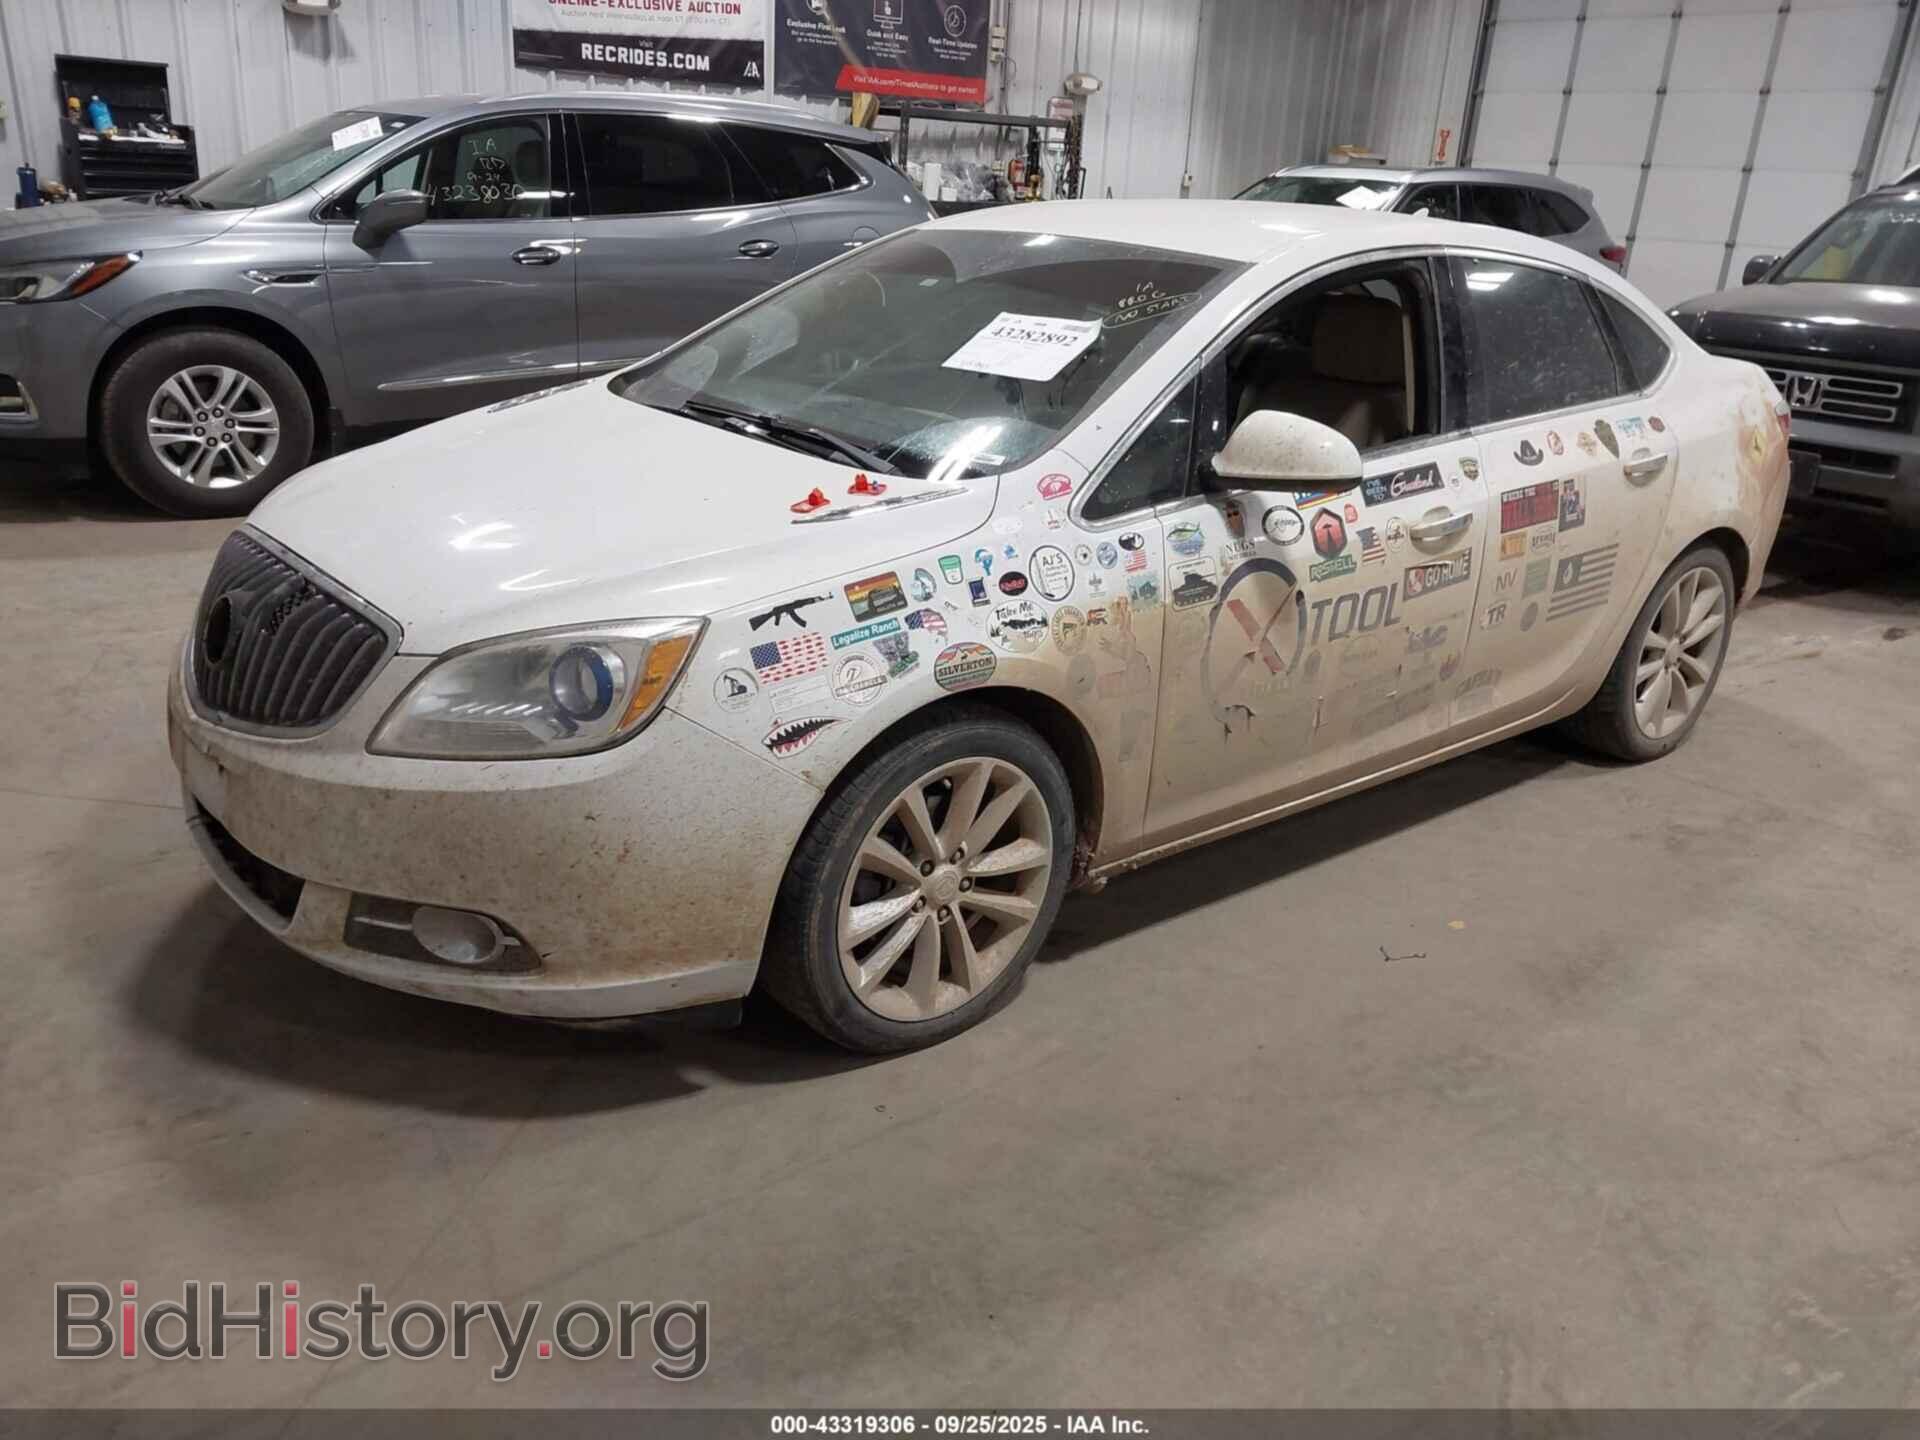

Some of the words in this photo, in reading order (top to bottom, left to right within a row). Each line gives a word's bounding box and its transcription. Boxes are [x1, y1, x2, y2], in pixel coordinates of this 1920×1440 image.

[688, 1, 741, 15] AUCTION
[581, 42, 710, 71] RECRIDES.COM
[991, 326, 1079, 347] 43282892
[1311, 582, 1401, 645] TOOL
[832, 629, 870, 647] Legalize
[871, 619, 899, 635] Ranch
[938, 657, 993, 677] SILVERTON
